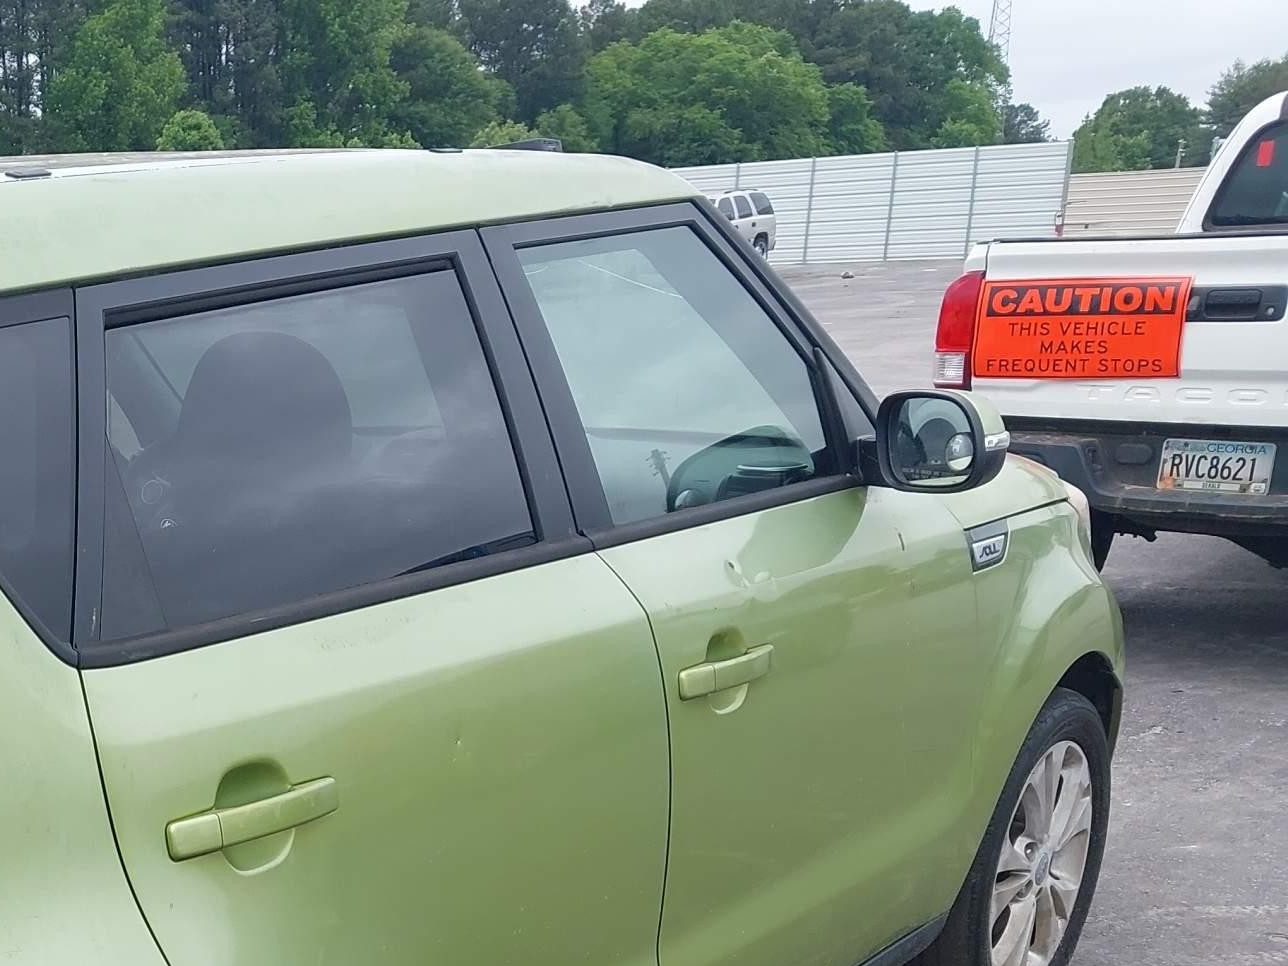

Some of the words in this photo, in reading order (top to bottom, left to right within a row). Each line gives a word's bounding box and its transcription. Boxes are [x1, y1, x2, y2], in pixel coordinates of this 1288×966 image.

[992, 286, 1176, 314] CAUTION
[1009, 322, 1051, 336] THIS
[1059, 321, 1146, 336] VEHICLE
[1039, 340, 1109, 354] MAKES
[986, 359, 1089, 373] FREQUENT
[1097, 358, 1163, 372] STOPS
[1077, 383, 1288, 405] TACO
[1207, 442, 1267, 455] GEORGIA
[1169, 453, 1257, 482] RVC8621
